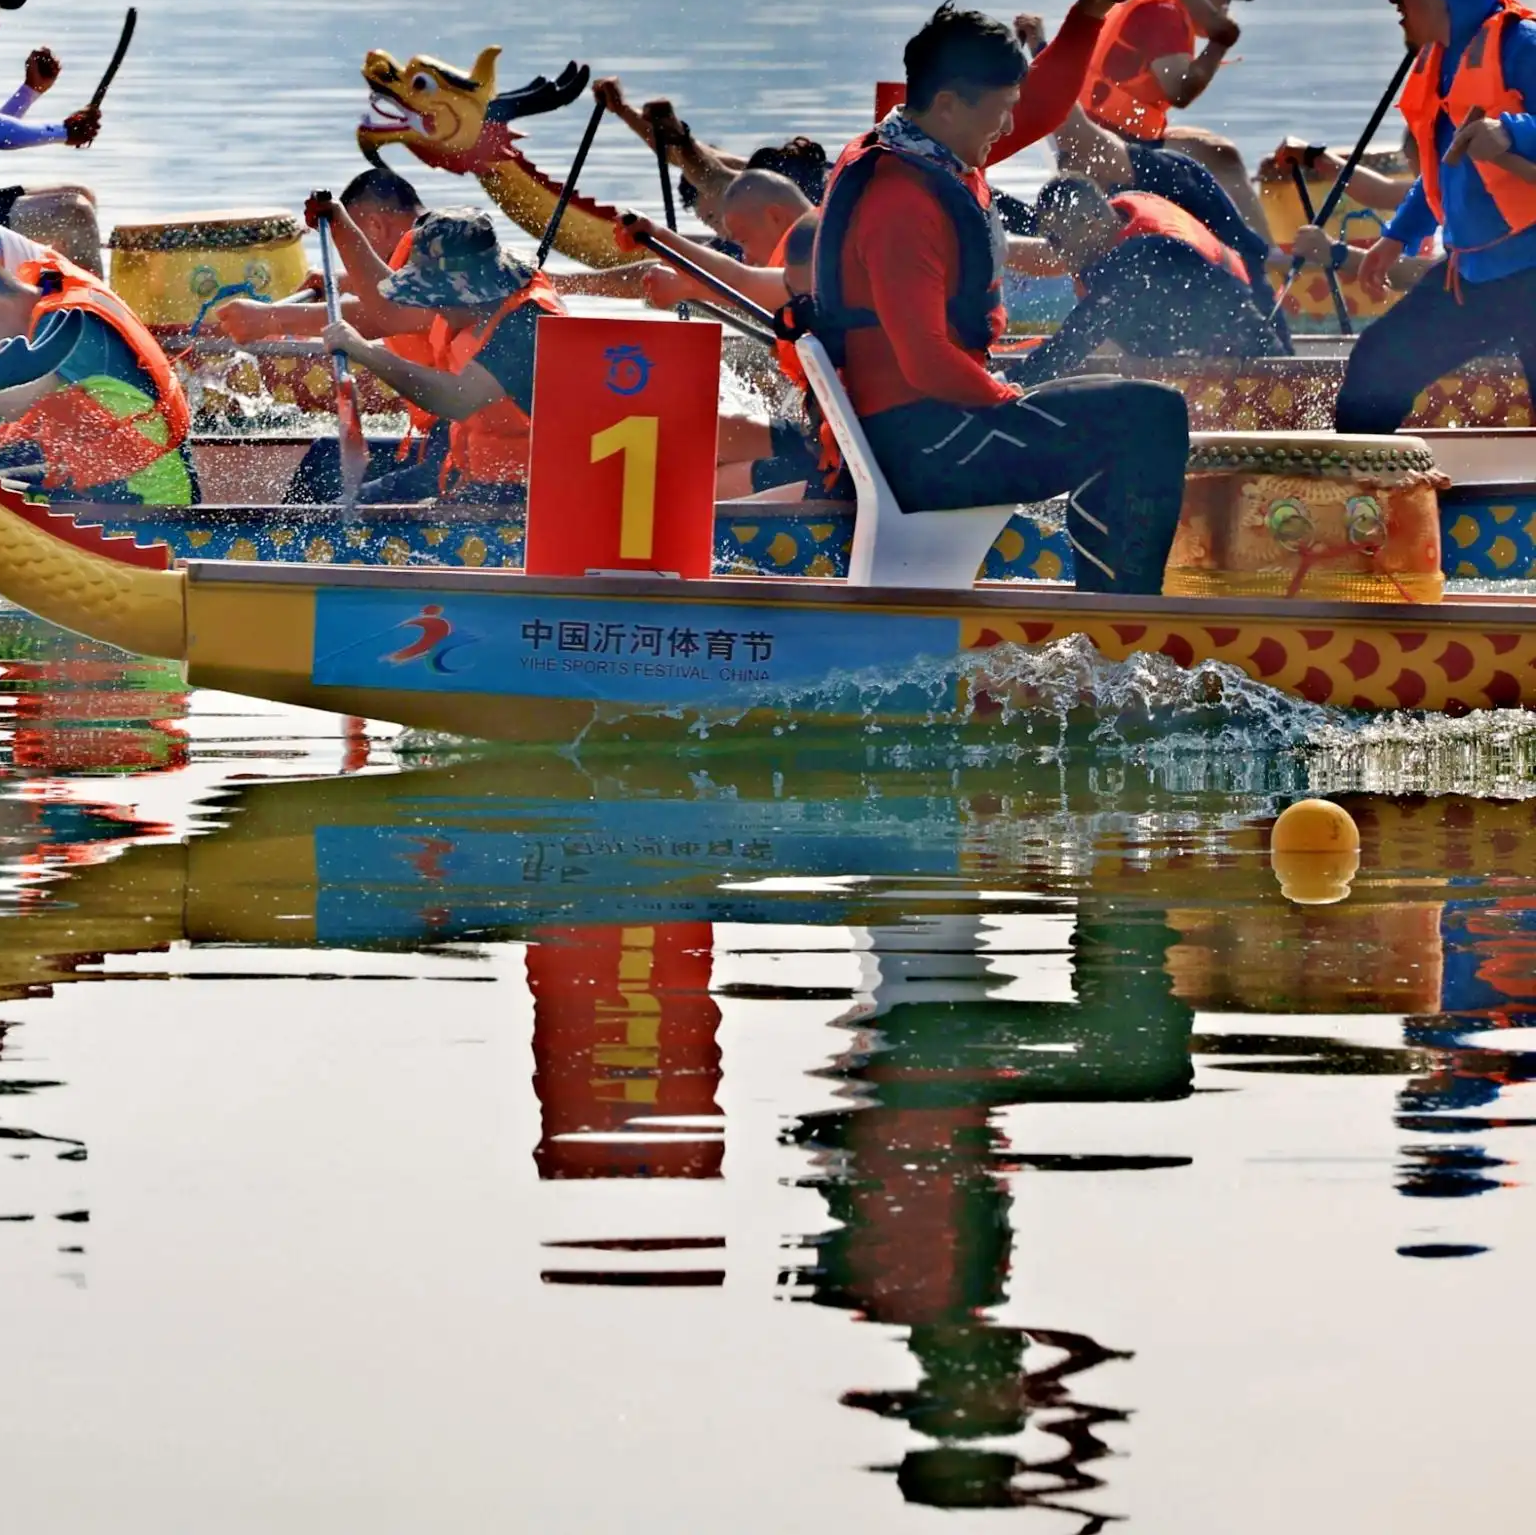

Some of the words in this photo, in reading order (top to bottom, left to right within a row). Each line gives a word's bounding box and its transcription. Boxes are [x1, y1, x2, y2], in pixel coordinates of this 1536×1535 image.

[590, 415, 659, 560] 1
[521, 618, 775, 663] 中国沂河体育节
[520, 657, 556, 672] YIHE
[562, 658, 628, 676] SPORTS
[719, 667, 770, 682] CHINA
